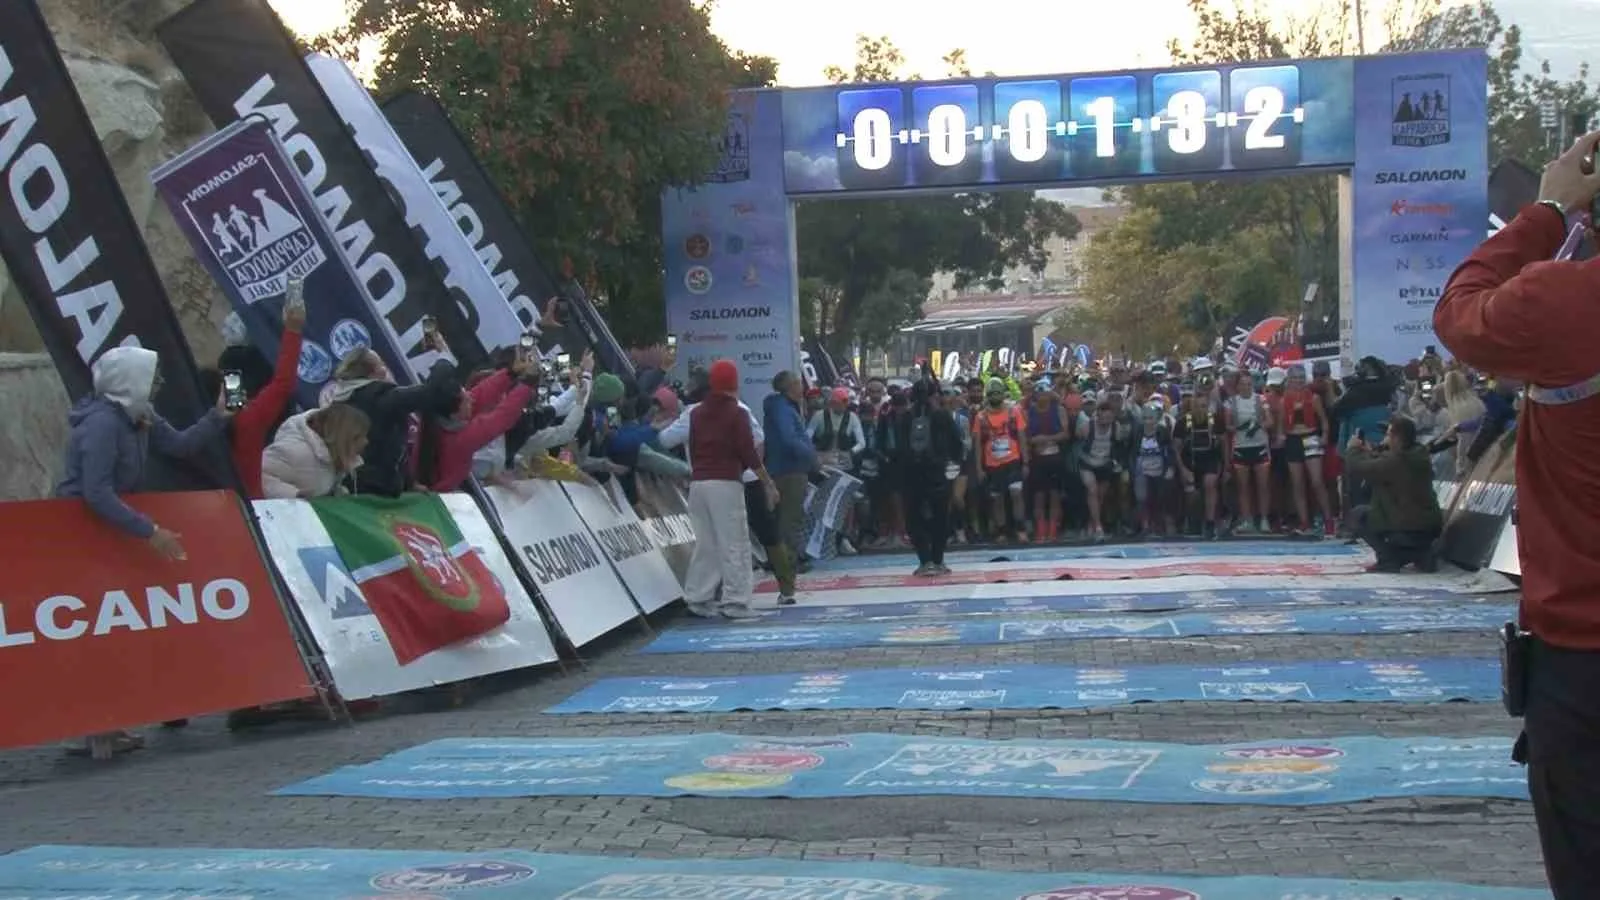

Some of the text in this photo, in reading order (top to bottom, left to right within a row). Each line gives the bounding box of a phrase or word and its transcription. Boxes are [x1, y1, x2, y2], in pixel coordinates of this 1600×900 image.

[1375, 169, 1466, 184] SALOMON
[1390, 231, 1449, 244] GARMIN
[690, 306, 771, 321] SALOMON
[522, 531, 601, 585] SALOMON
